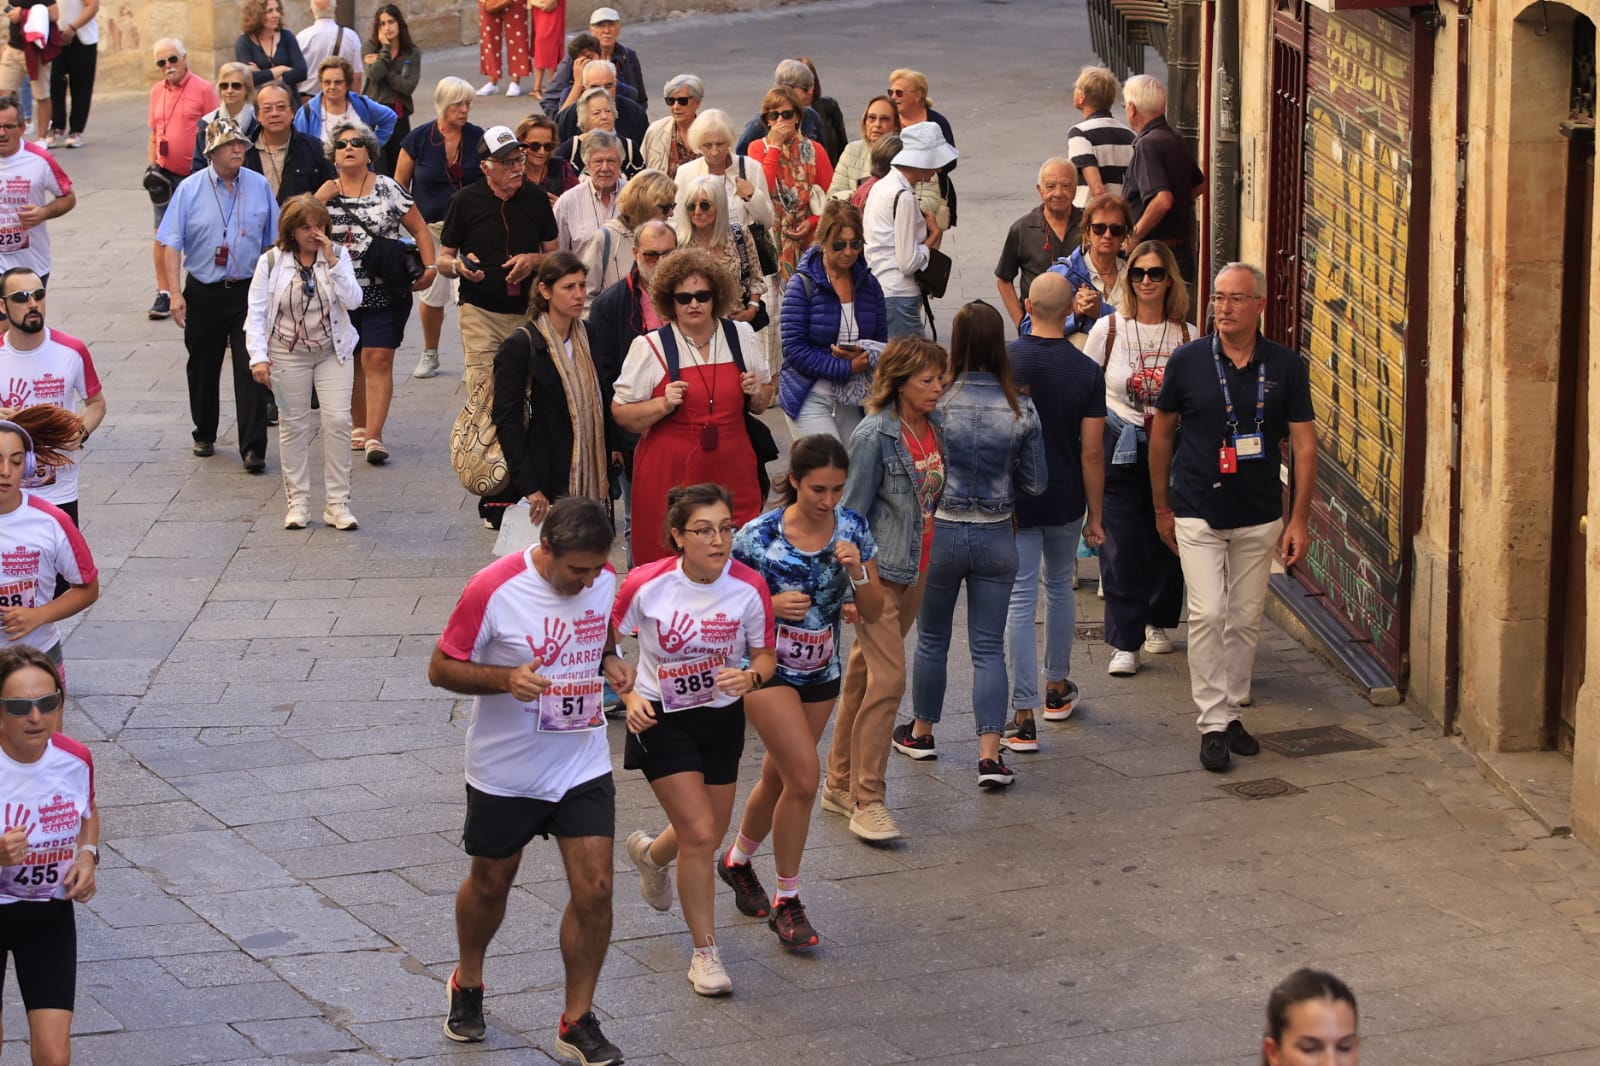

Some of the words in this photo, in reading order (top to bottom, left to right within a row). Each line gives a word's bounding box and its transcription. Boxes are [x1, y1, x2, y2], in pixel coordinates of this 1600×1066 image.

[0, 233, 21, 245] 225
[684, 645, 734, 657] CARRERA
[790, 642, 824, 660] 311
[674, 670, 714, 695] 385
[562, 696, 584, 716] 51
[14, 863, 59, 885] 455
